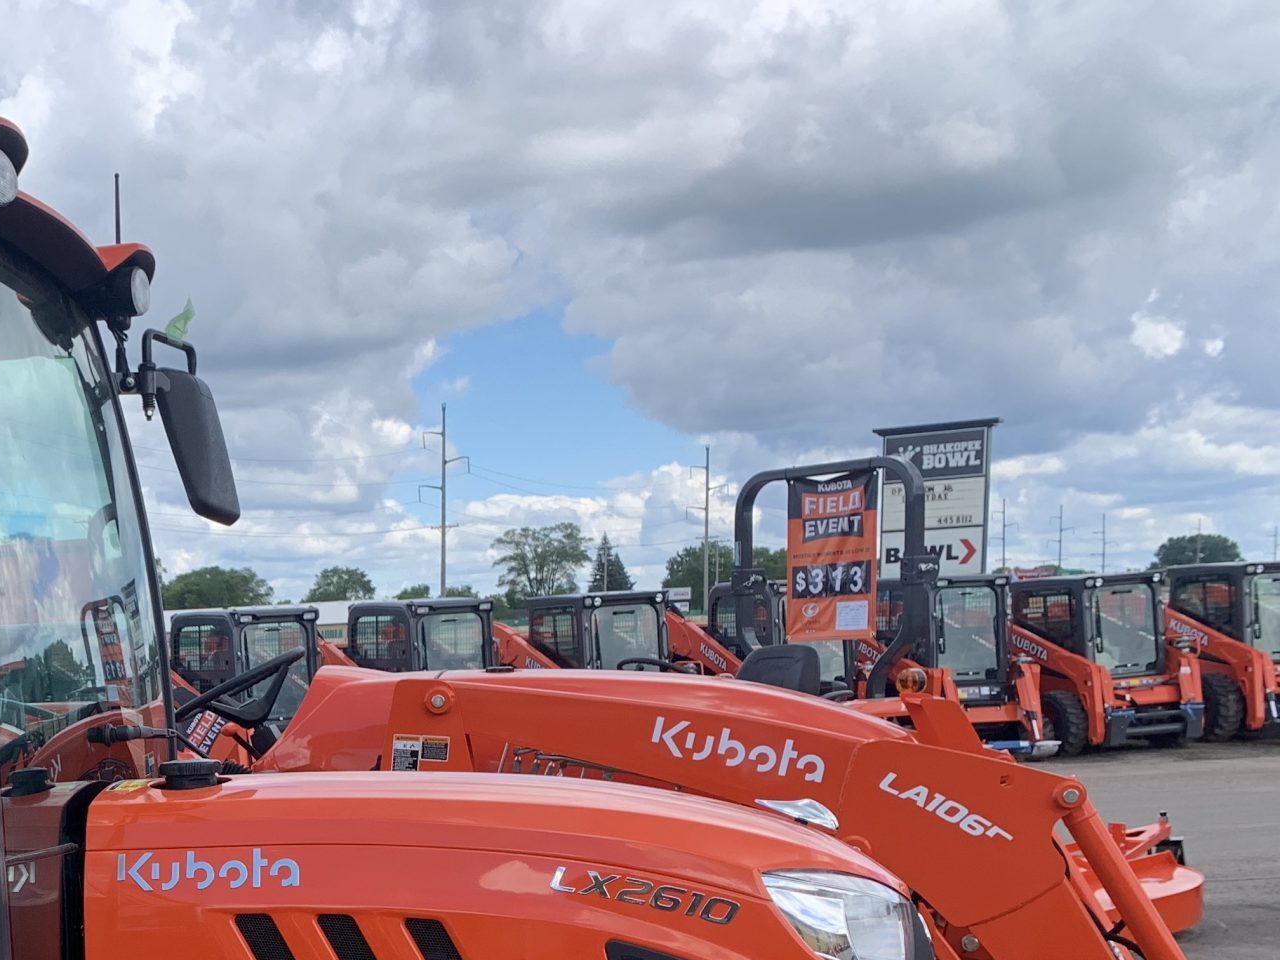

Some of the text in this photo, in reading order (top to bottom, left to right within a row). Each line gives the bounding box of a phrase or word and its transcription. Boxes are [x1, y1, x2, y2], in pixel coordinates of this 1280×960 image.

[922, 440, 982, 454] SHAKOPEE
[922, 450, 981, 470] BOWL
[817, 480, 853, 492] KUBOTA
[805, 491, 861, 516] FIELD
[804, 516, 862, 539] EVENT
[885, 544, 959, 564] BWL
[795, 565, 863, 594] $313
[1169, 619, 1209, 646] KUBOTA
[699, 642, 727, 672] KUBOTA
[1010, 634, 1049, 661] KUBOTA
[186, 713, 203, 734] KUBOTA
[189, 710, 216, 748] FIELD
[200, 716, 226, 754] EVENT
[651, 715, 825, 784] Kubota
[117, 847, 300, 892] Kubota
[549, 866, 741, 925] LX2610
